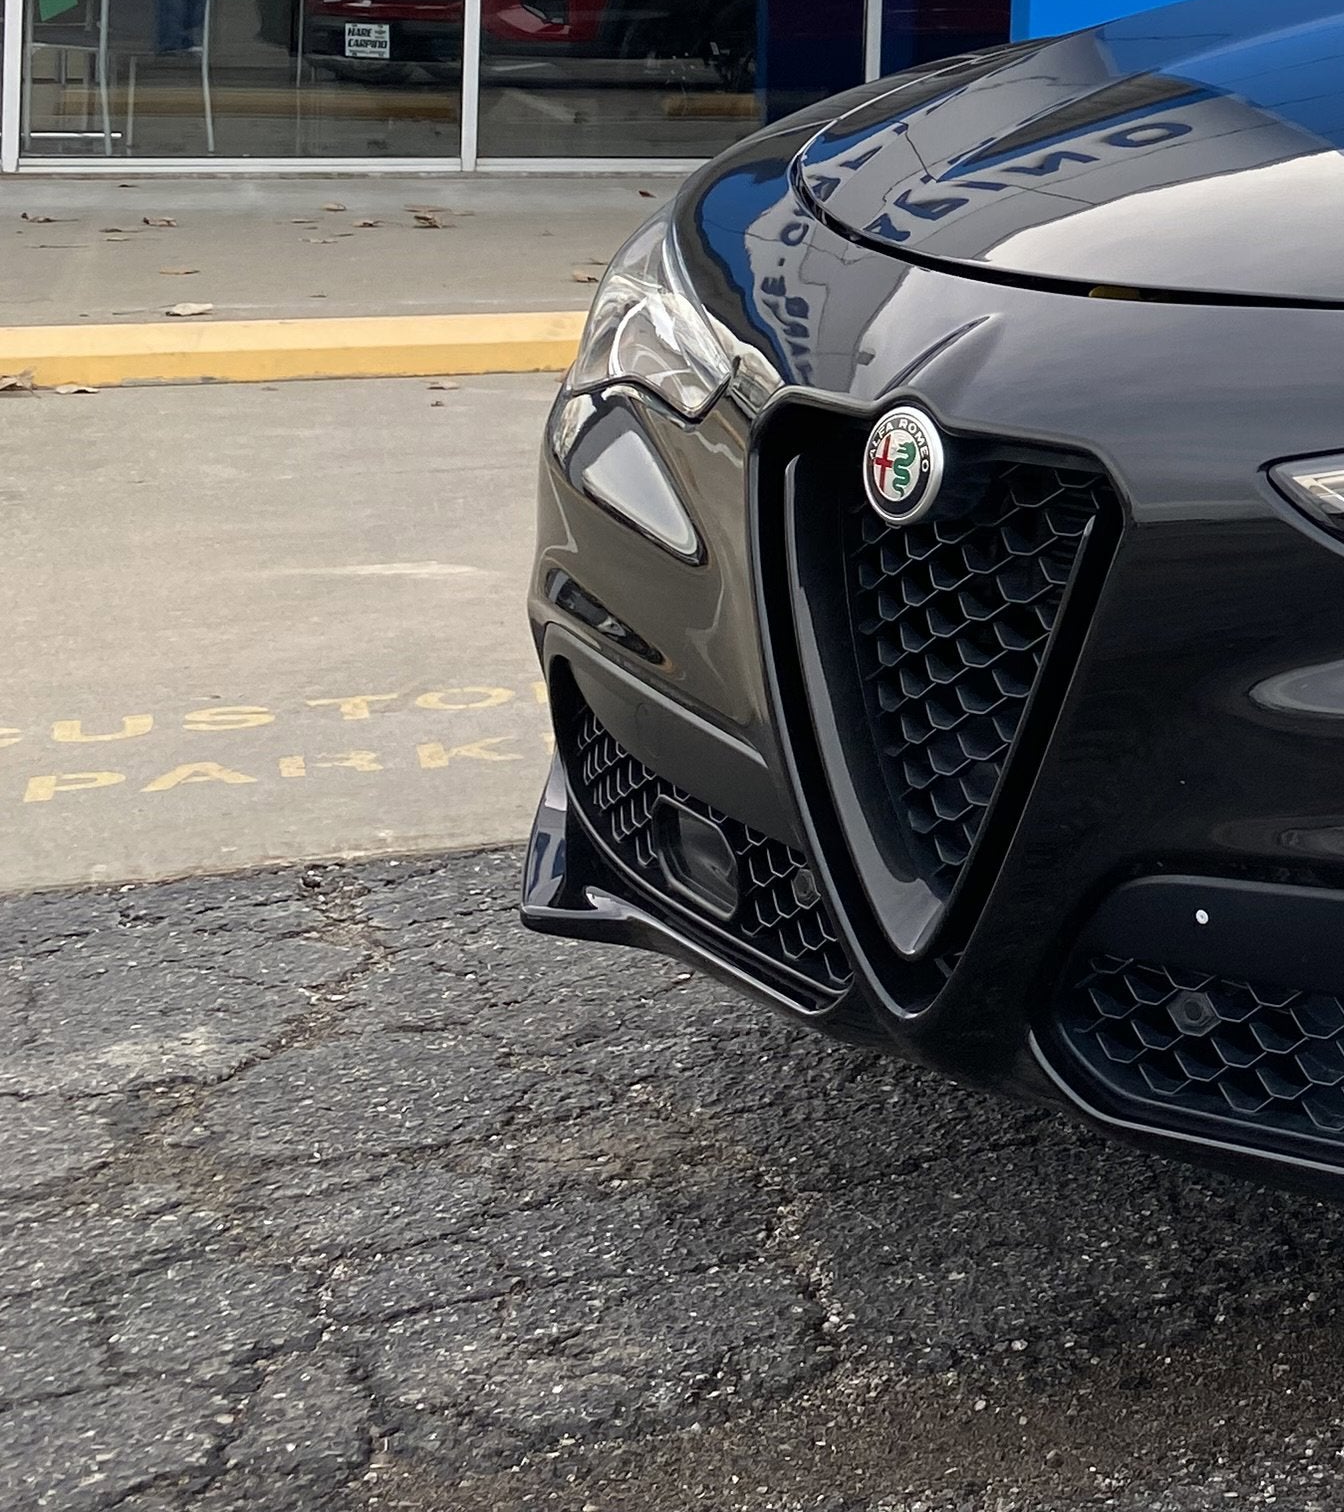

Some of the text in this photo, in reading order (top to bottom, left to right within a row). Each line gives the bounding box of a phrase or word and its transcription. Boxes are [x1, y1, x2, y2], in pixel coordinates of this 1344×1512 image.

[868, 418, 930, 473] ALFA ROMEO
[0, 681, 550, 748] USTO
[23, 731, 557, 803] PARK
